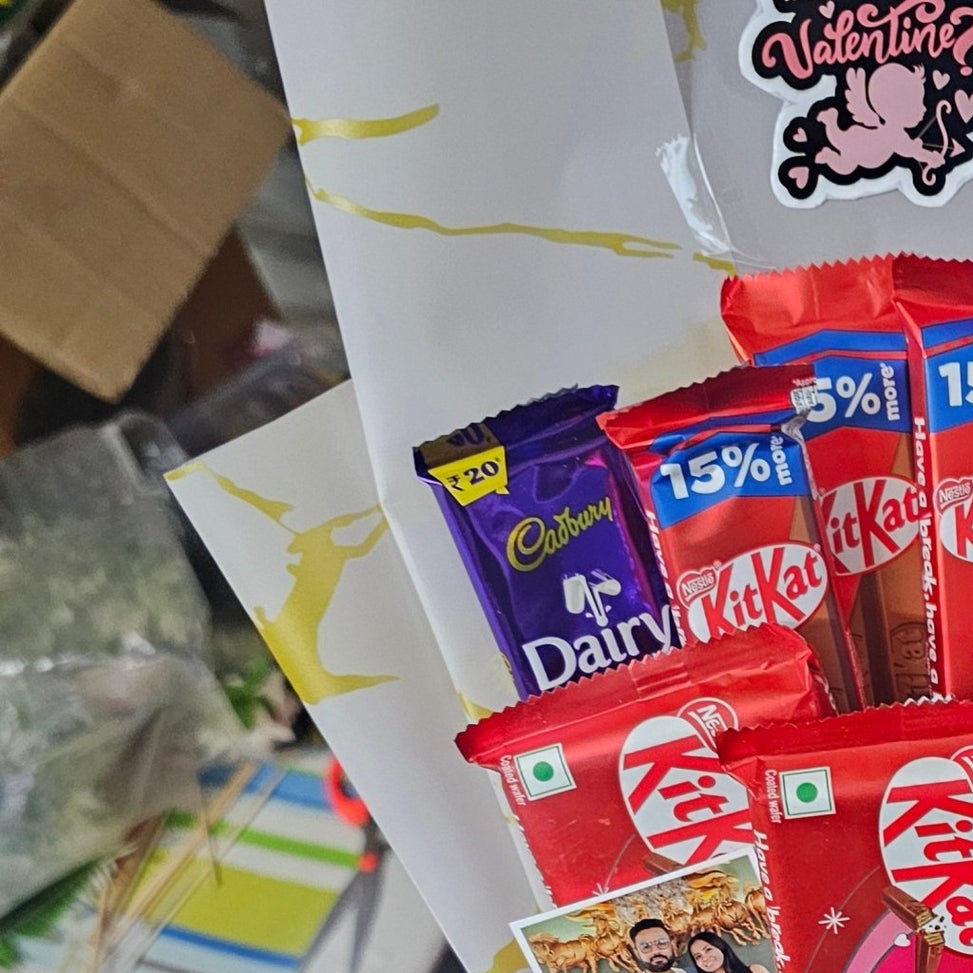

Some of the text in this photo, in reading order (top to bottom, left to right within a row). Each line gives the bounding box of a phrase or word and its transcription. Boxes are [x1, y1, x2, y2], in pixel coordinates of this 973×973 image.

[803, 373, 882, 424] 5%
[660, 443, 771, 500] 15%
[914, 417, 927, 486] Have
[506, 498, 614, 573] Cadbury
[918, 494, 927, 508] a
[701, 547, 823, 641] KitKat
[521, 603, 673, 692] Dairy
[925, 603, 938, 661] have
[753, 829, 770, 885] Have
[763, 886, 774, 902] a
